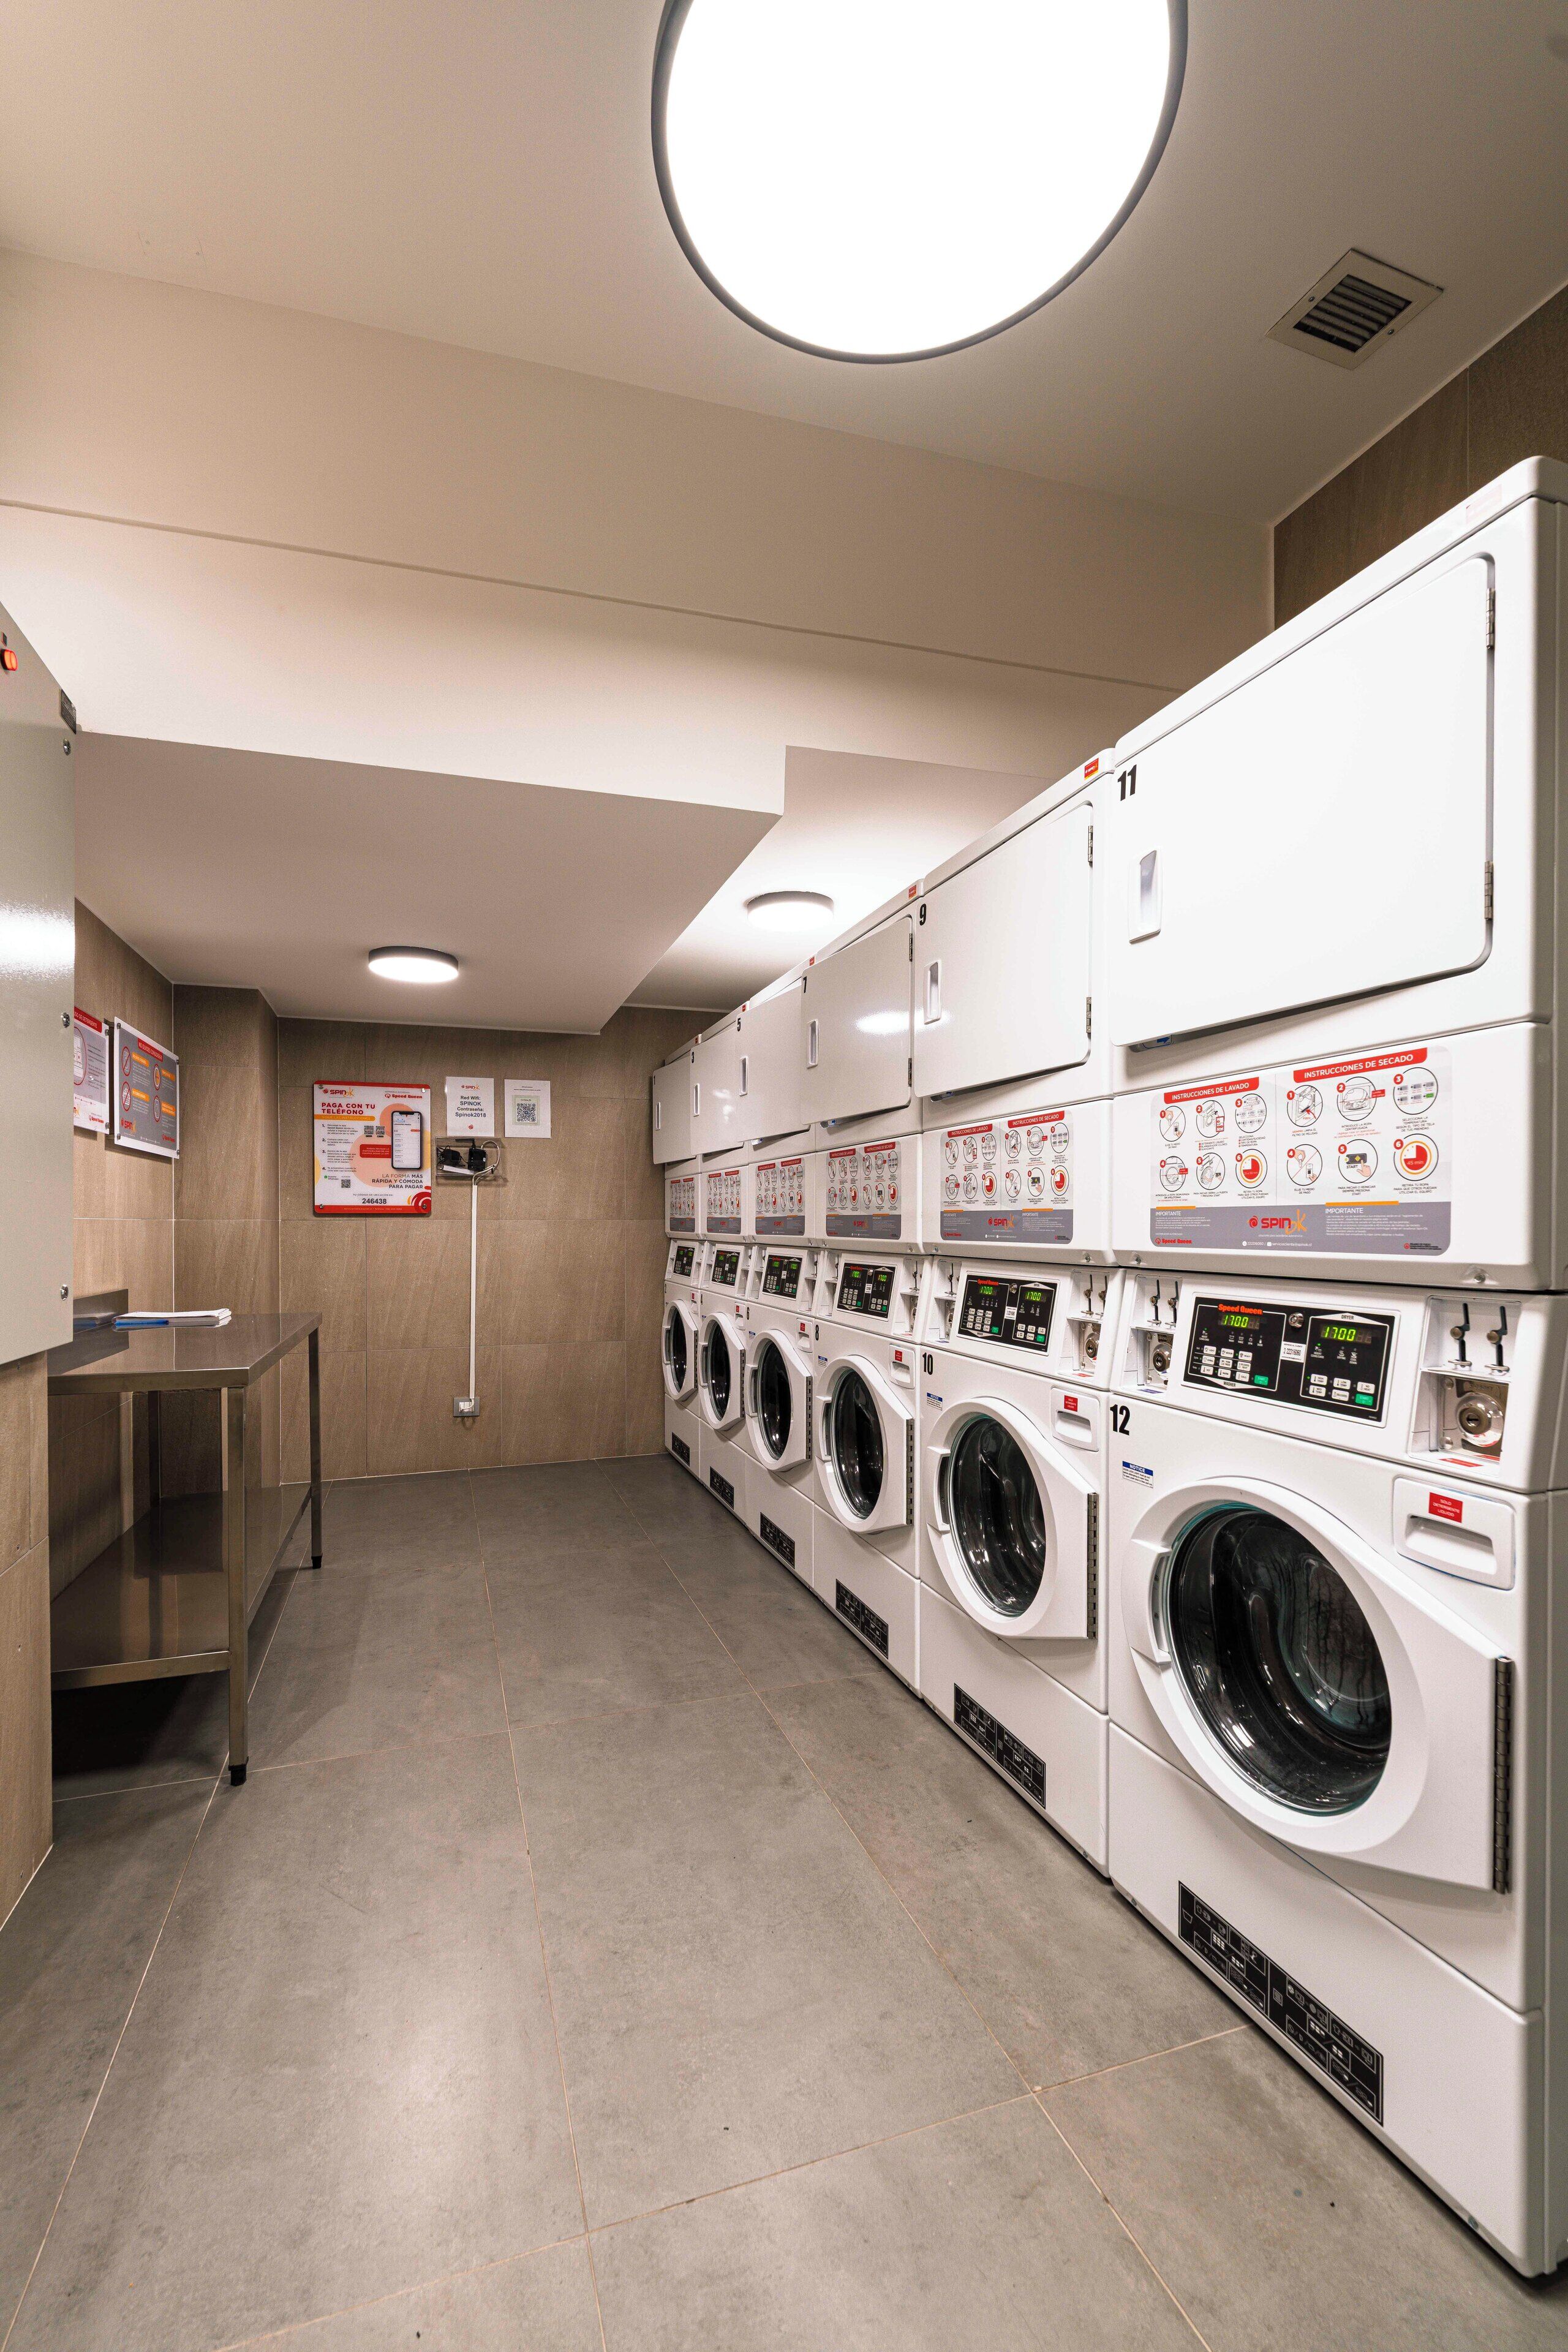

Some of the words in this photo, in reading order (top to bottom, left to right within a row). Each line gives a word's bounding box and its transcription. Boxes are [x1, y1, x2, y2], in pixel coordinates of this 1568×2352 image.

[1118, 764, 1137, 801] 11
[919, 903, 926, 925] 9
[803, 976, 807, 993] 7
[83, 1016, 97, 1028] DETERGENTE
[737, 1017, 741, 1031] 5
[692, 1052, 694, 1063] 3
[1304, 1063, 1363, 1079] INSTRUCCIONES
[1378, 1054, 1414, 1066] SECADO
[654, 1076, 655, 1085] 1
[1172, 1089, 1214, 1100] INSTRUCCIONES
[1224, 1082, 1250, 1092] LAVADO
[981, 1286, 993, 1295] 1700
[1027, 1292, 1041, 1301] 1700
[747, 1306, 750, 1321] 6
[1218, 1303, 1239, 1312] Speed
[1240, 1306, 1263, 1315] Queen
[1223, 1315, 1249, 1328] 1700
[815, 1324, 819, 1341] 8
[1325, 1327, 1357, 1341] 1700
[922, 1352, 933, 1375] 10
[1110, 1404, 1130, 1436] 12
[1129, 1464, 1145, 1473] NOTICE
[1433, 1502, 1460, 1513] DETERGENTE
